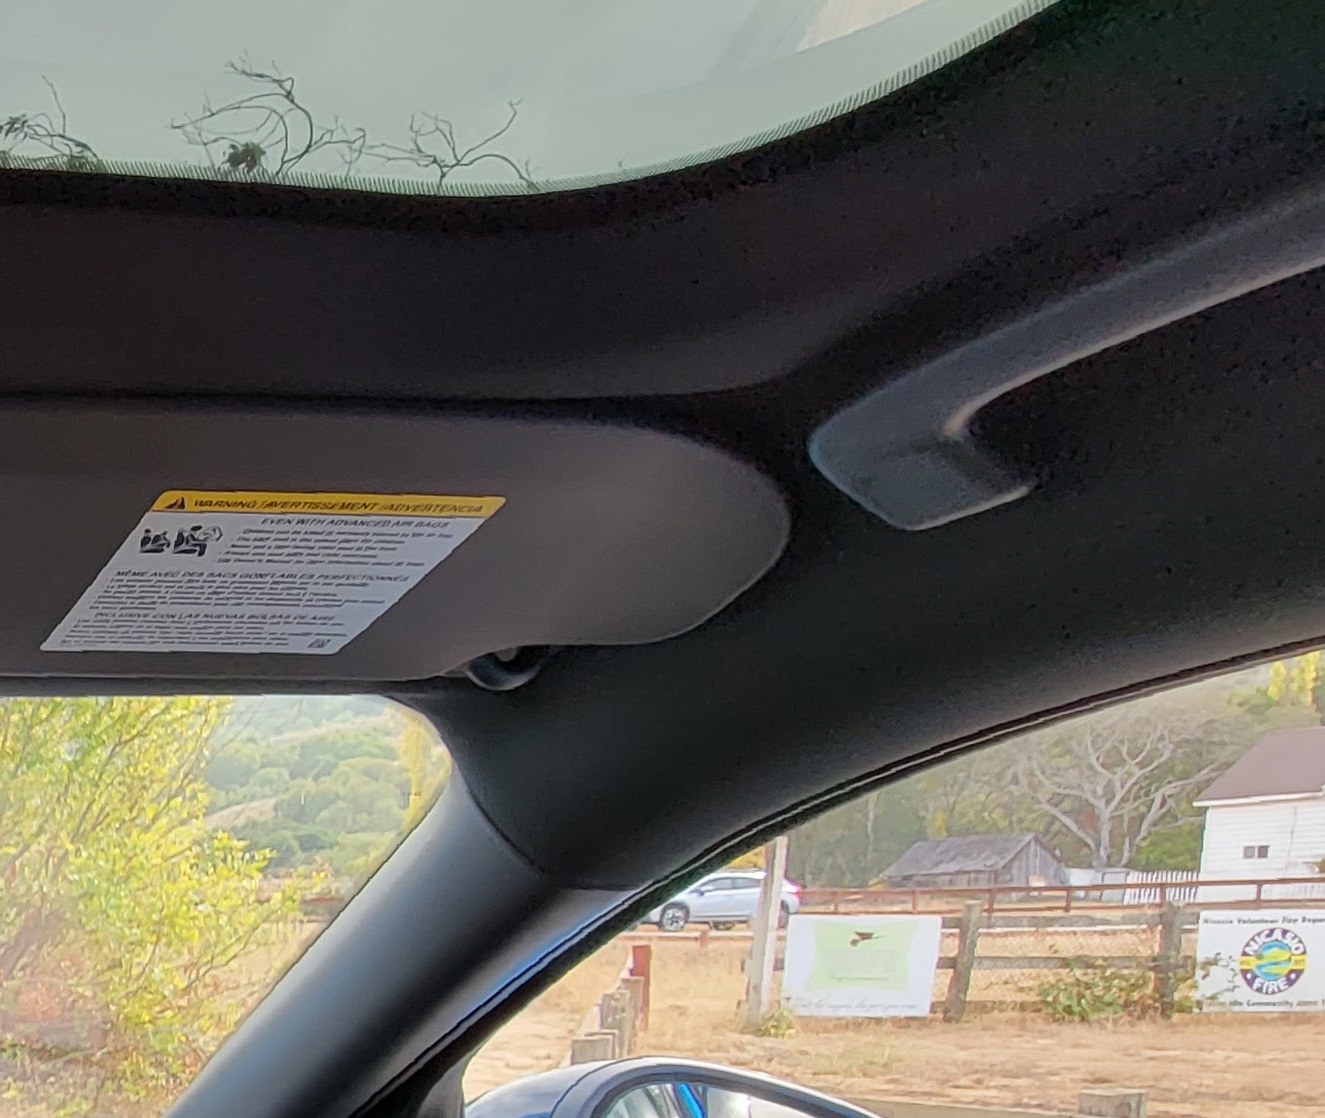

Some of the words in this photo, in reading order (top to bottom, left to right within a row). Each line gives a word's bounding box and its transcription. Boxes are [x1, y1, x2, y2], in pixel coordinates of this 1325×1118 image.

[194, 499, 256, 509] WARNING
[261, 517, 293, 526] EVEN
[295, 518, 326, 527] WITH
[327, 519, 391, 528] ADVANCED
[391, 520, 413, 529] AIR
[413, 520, 450, 529] BAGS
[149, 570, 181, 579] AVEC
[238, 572, 316, 580] GONFLABLES
[1243, 928, 1305, 956] NICASIO
[1252, 977, 1290, 995] FIRE
